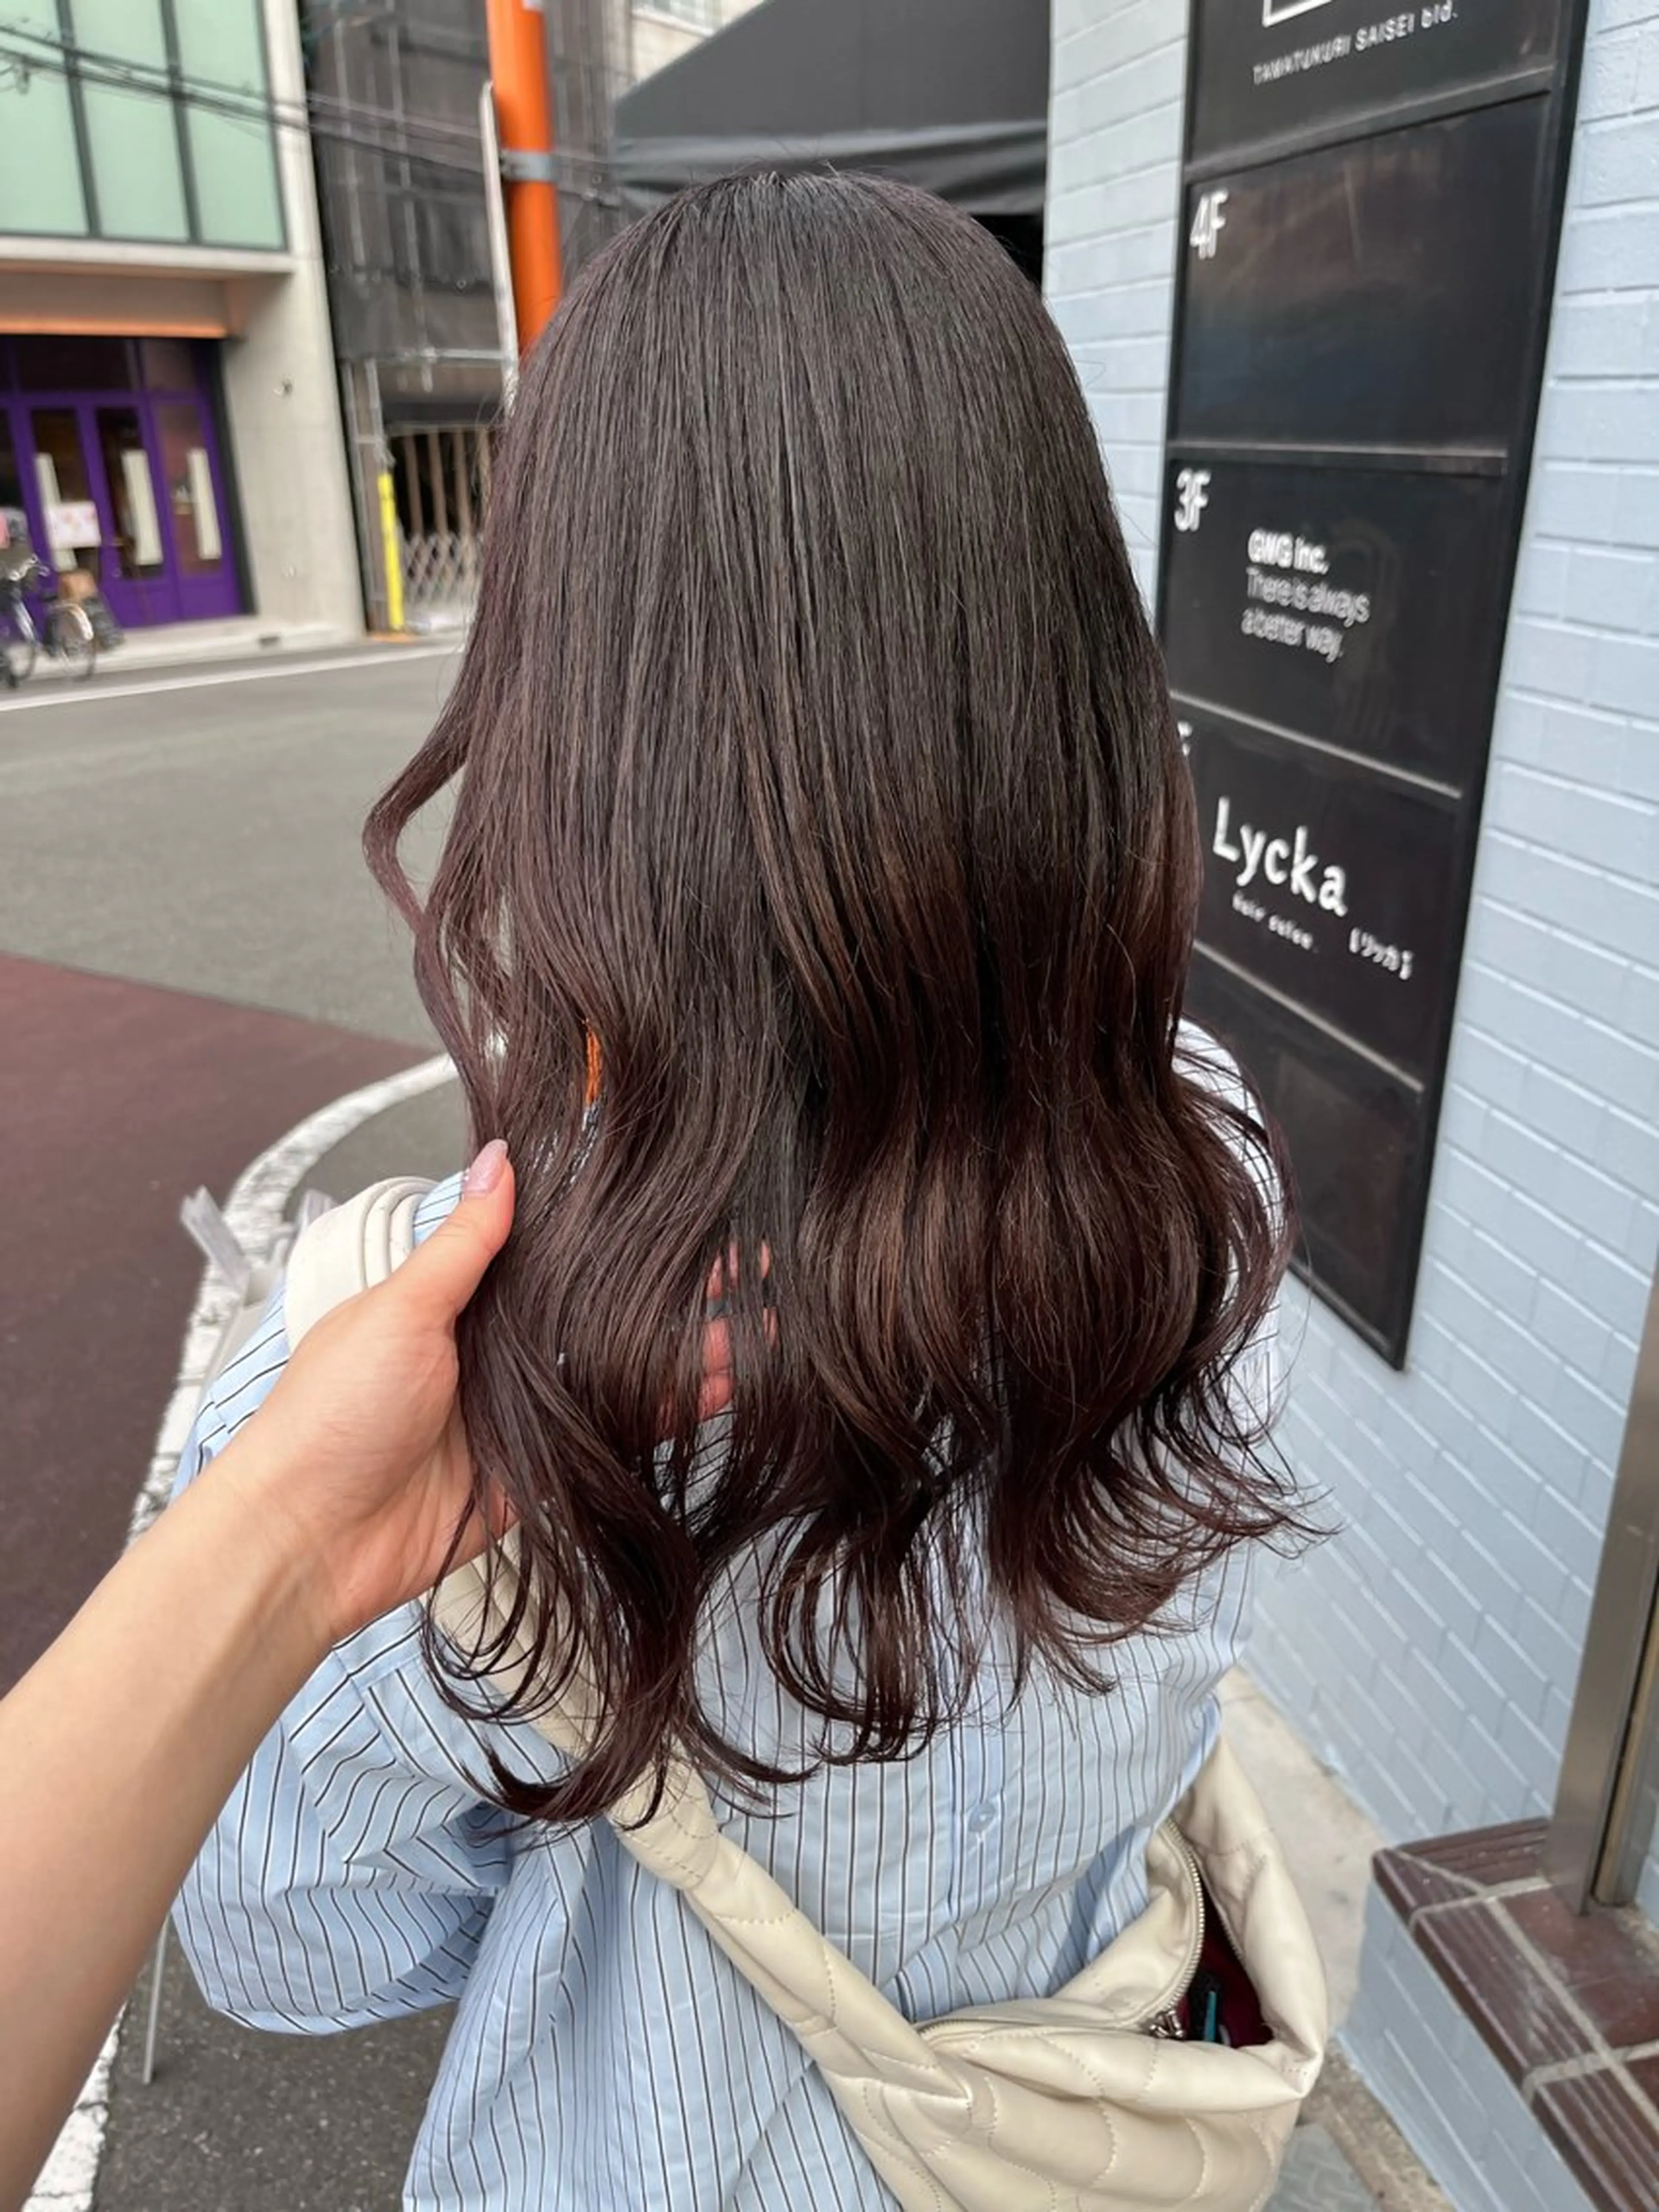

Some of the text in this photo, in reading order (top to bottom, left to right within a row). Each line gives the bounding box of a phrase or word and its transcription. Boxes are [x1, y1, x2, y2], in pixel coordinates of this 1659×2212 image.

[1355, 13, 1415, 51] SAISEI
[1190, 188, 1229, 260] 4F
[1174, 467, 1211, 532] 3F
[1307, 582, 1370, 628] always
[1213, 795, 1348, 917] Lycka
